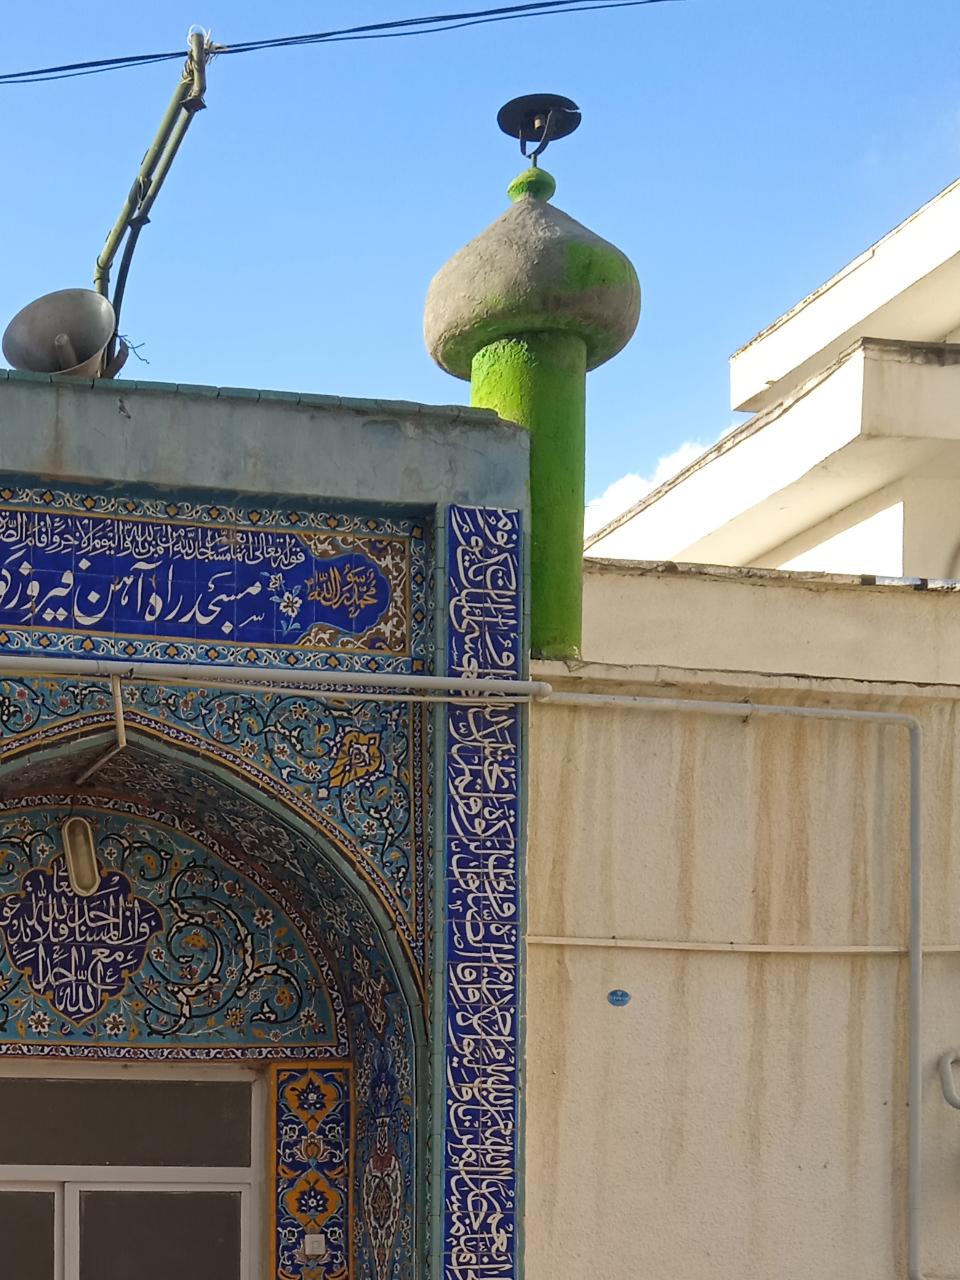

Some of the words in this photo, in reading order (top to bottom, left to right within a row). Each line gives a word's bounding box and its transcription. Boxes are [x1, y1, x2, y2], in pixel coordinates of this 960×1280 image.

[74, 560, 162, 626] آهن
[144, 564, 183, 622] راه
[178, 572, 262, 635] مسجد
